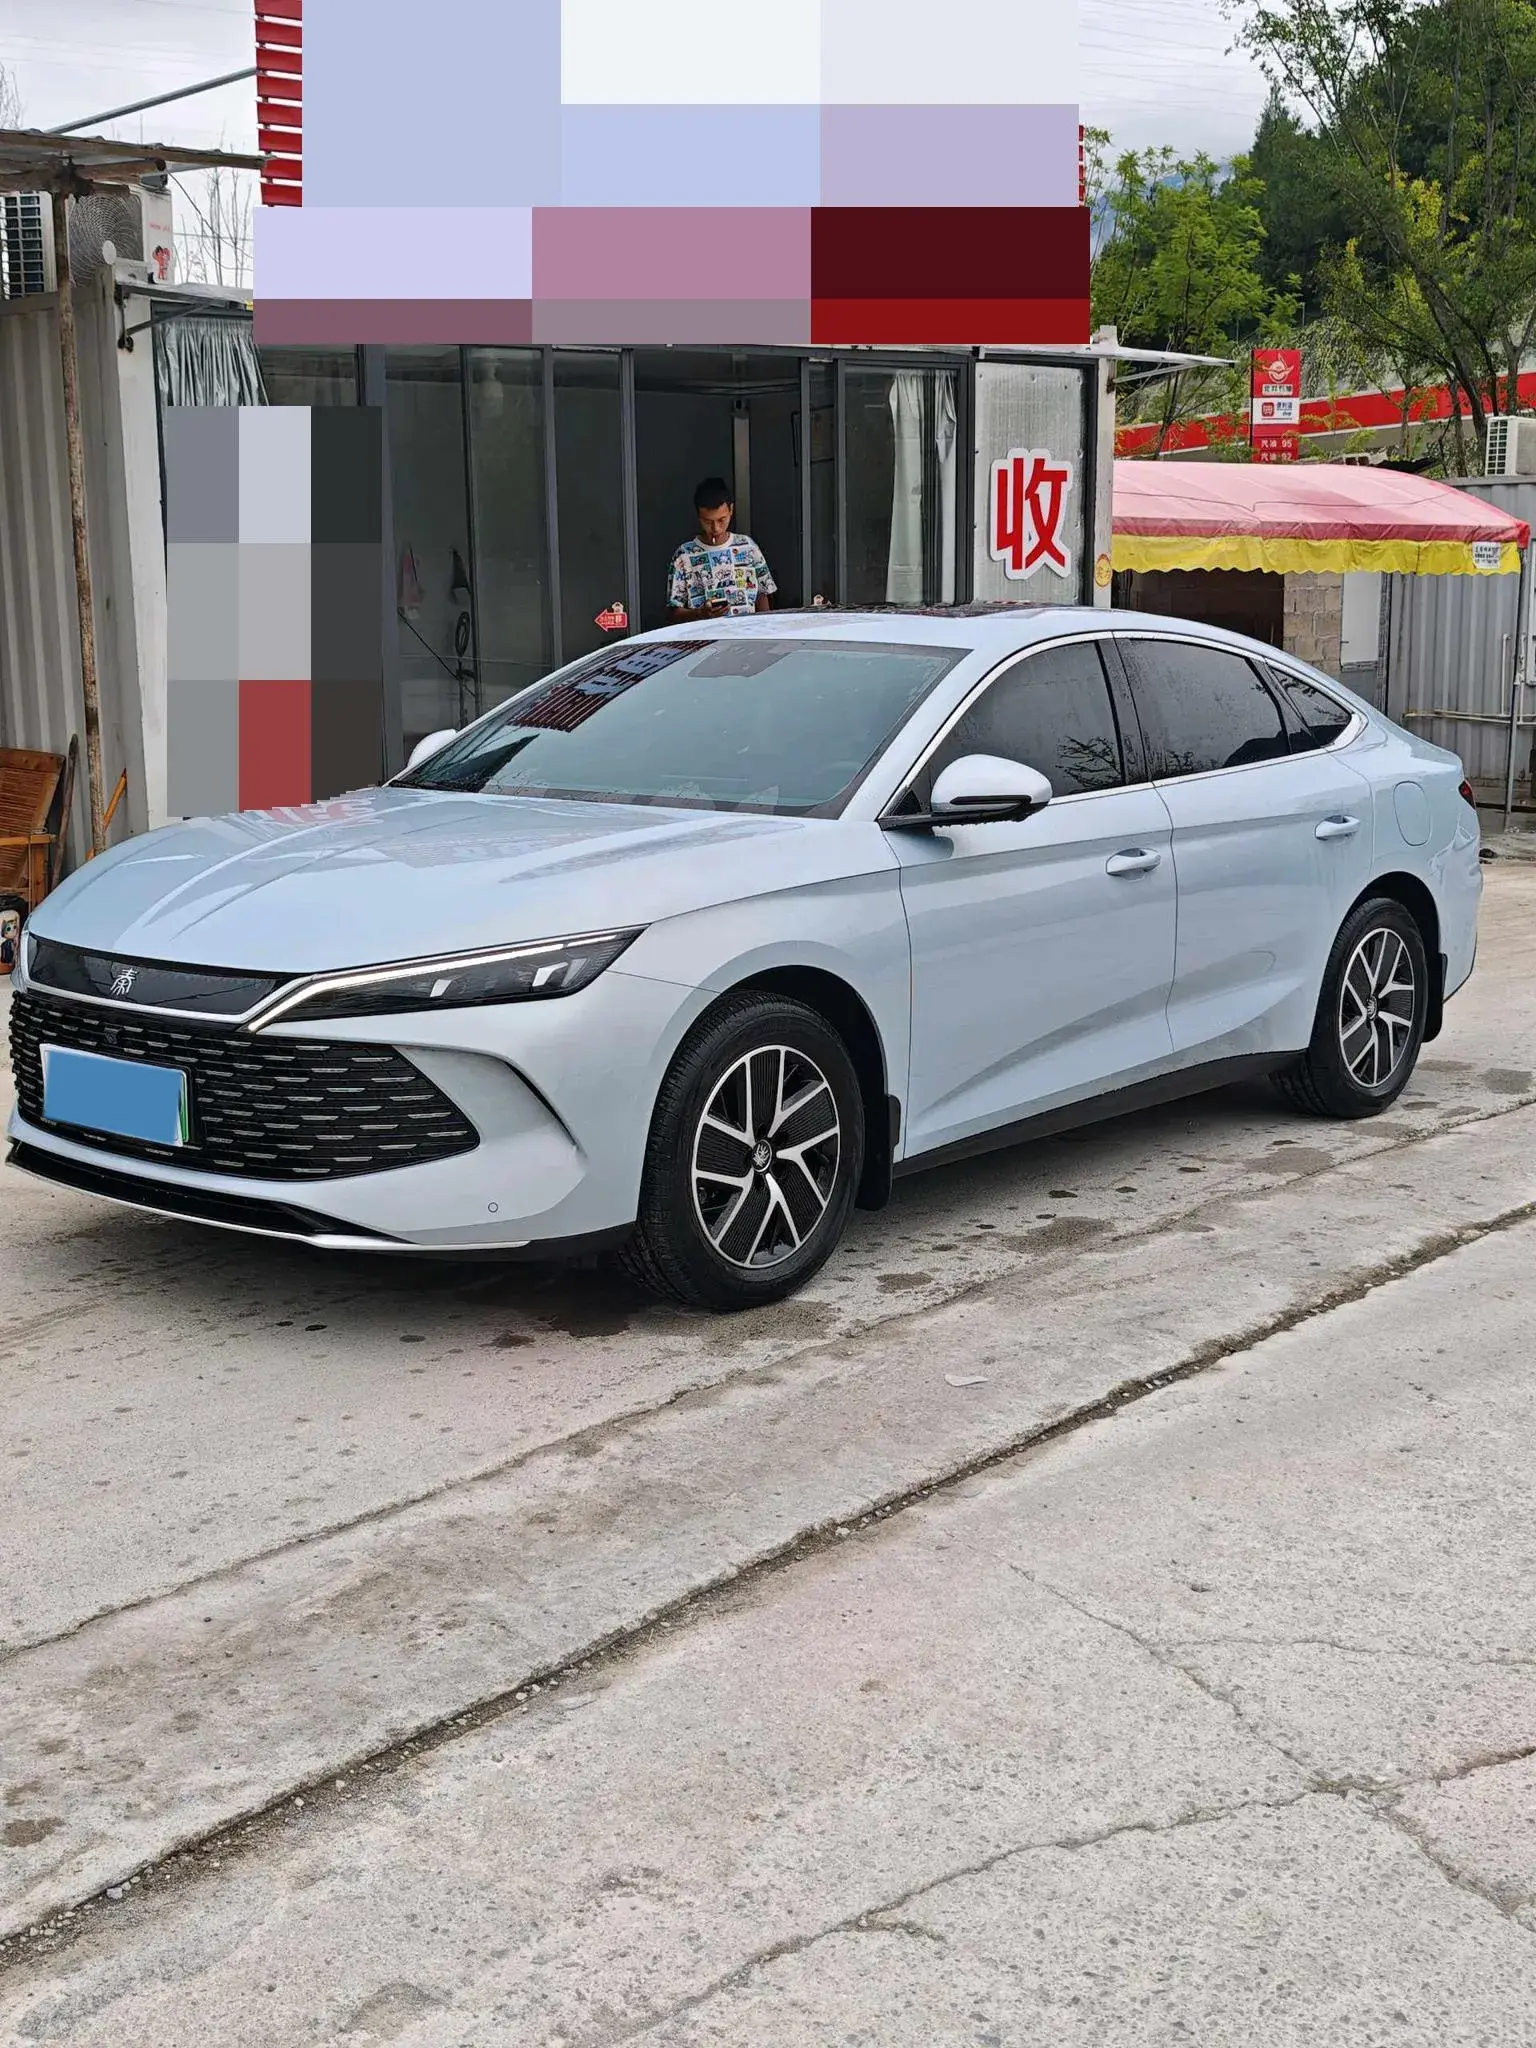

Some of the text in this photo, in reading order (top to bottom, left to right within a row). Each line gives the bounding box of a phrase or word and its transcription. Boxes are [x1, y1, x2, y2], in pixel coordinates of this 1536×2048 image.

[1281, 439, 1293, 448] 95
[997, 457, 1067, 570] 收
[111, 968, 138, 996] 秦
